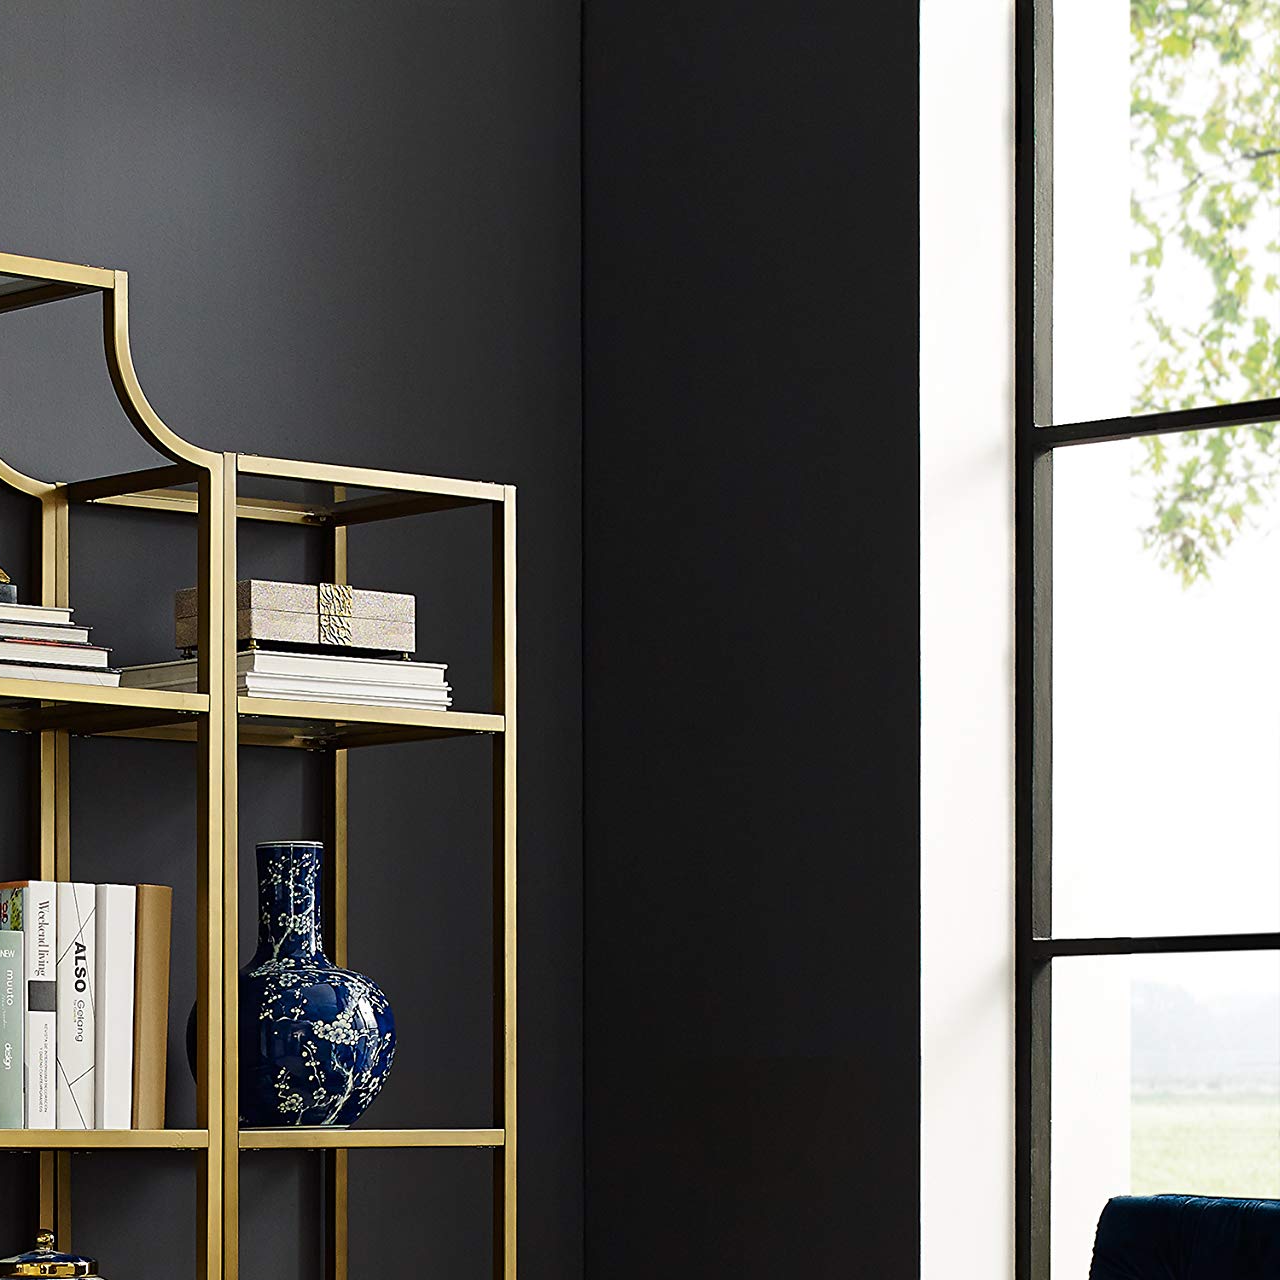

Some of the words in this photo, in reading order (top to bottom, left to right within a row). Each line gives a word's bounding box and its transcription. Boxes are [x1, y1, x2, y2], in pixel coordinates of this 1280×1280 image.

[38, 901, 50, 948] Weekend
[0, 949, 16, 958] NEW
[34, 949, 50, 977] living
[74, 941, 87, 993] ALSO
[6, 969, 14, 1006] muuto
[2, 1042, 13, 1070] design
